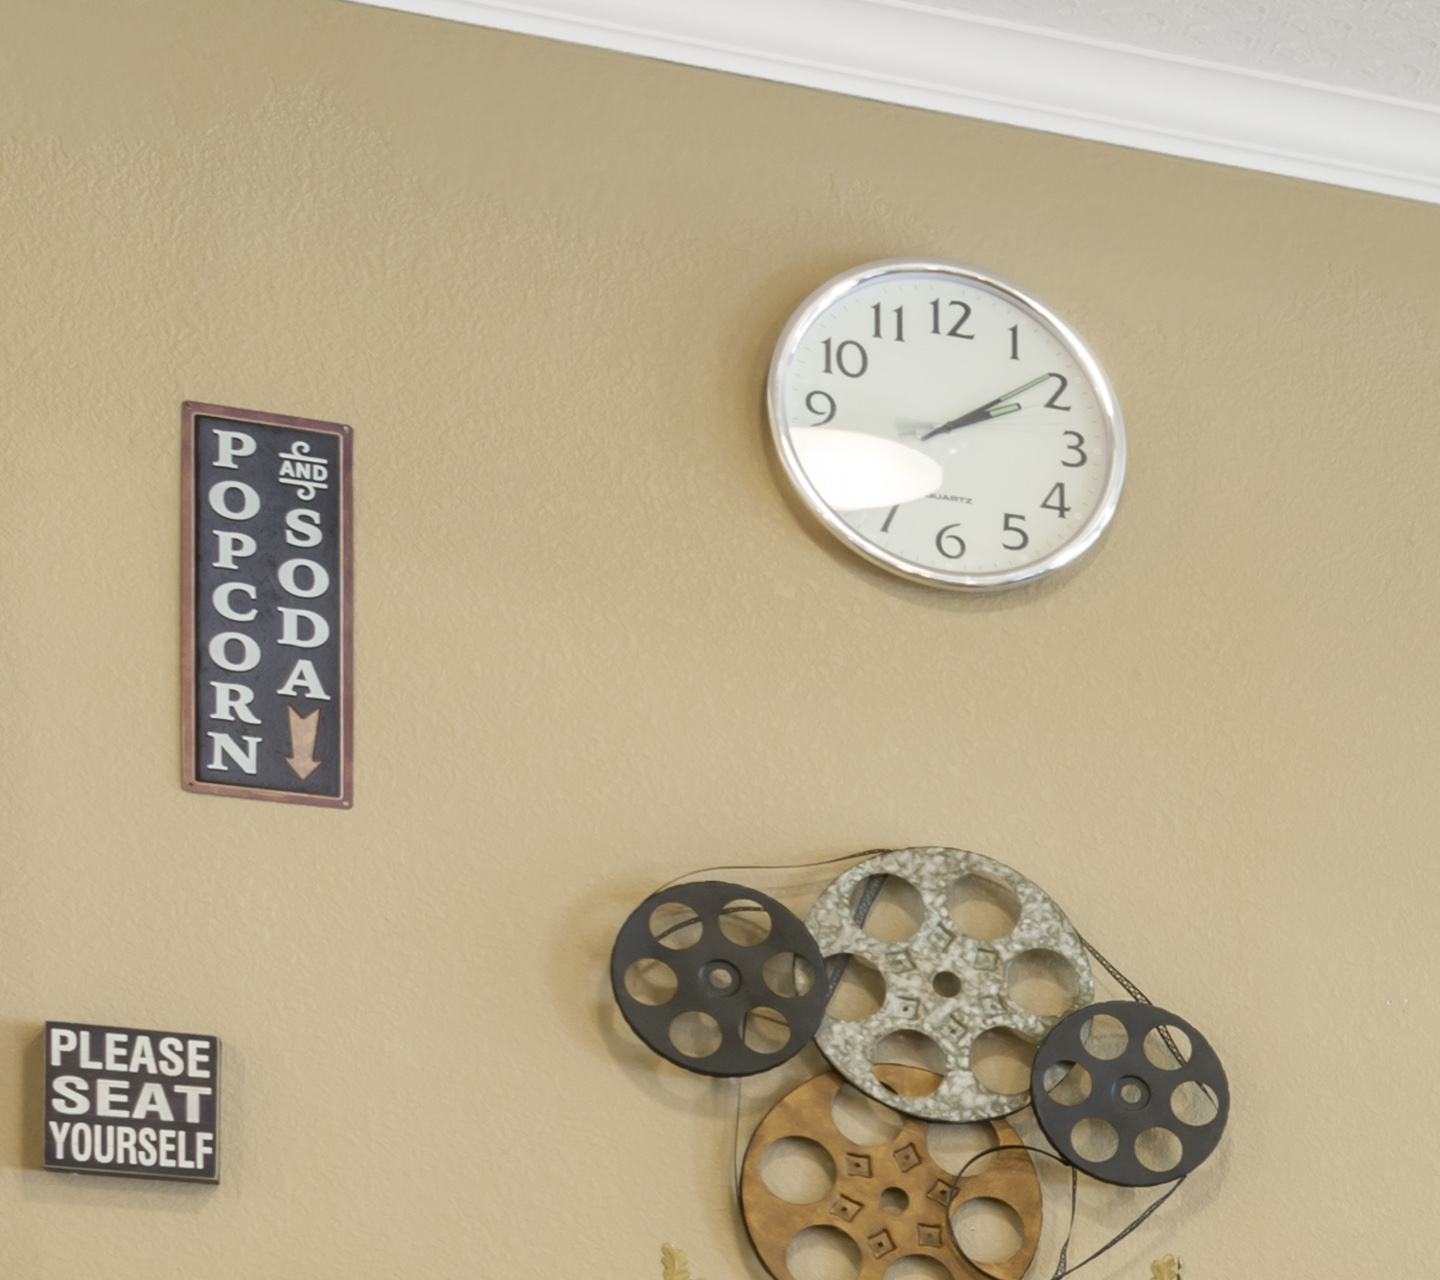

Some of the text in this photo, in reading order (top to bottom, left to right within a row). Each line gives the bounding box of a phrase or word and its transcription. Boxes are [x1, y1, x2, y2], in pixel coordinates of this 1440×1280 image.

[870, 302, 905, 342] 11
[929, 298, 975, 340] 12
[821, 337, 868, 378] 10
[1008, 324, 1020, 360] 1
[805, 390, 837, 427] 9
[1043, 372, 1071, 411] 2
[1060, 430, 1088, 468] 3
[279, 462, 328, 482] AND
[1040, 482, 1071, 519] 4
[935, 523, 966, 559] 6
[1002, 513, 1029, 550] 5
[207, 429, 262, 775] POPCORN
[277, 508, 330, 700] SODA
[50, 1028, 211, 1079] PLEASE
[51, 1074, 212, 1123] SEAT
[49, 1121, 213, 1169] YOURSELF
